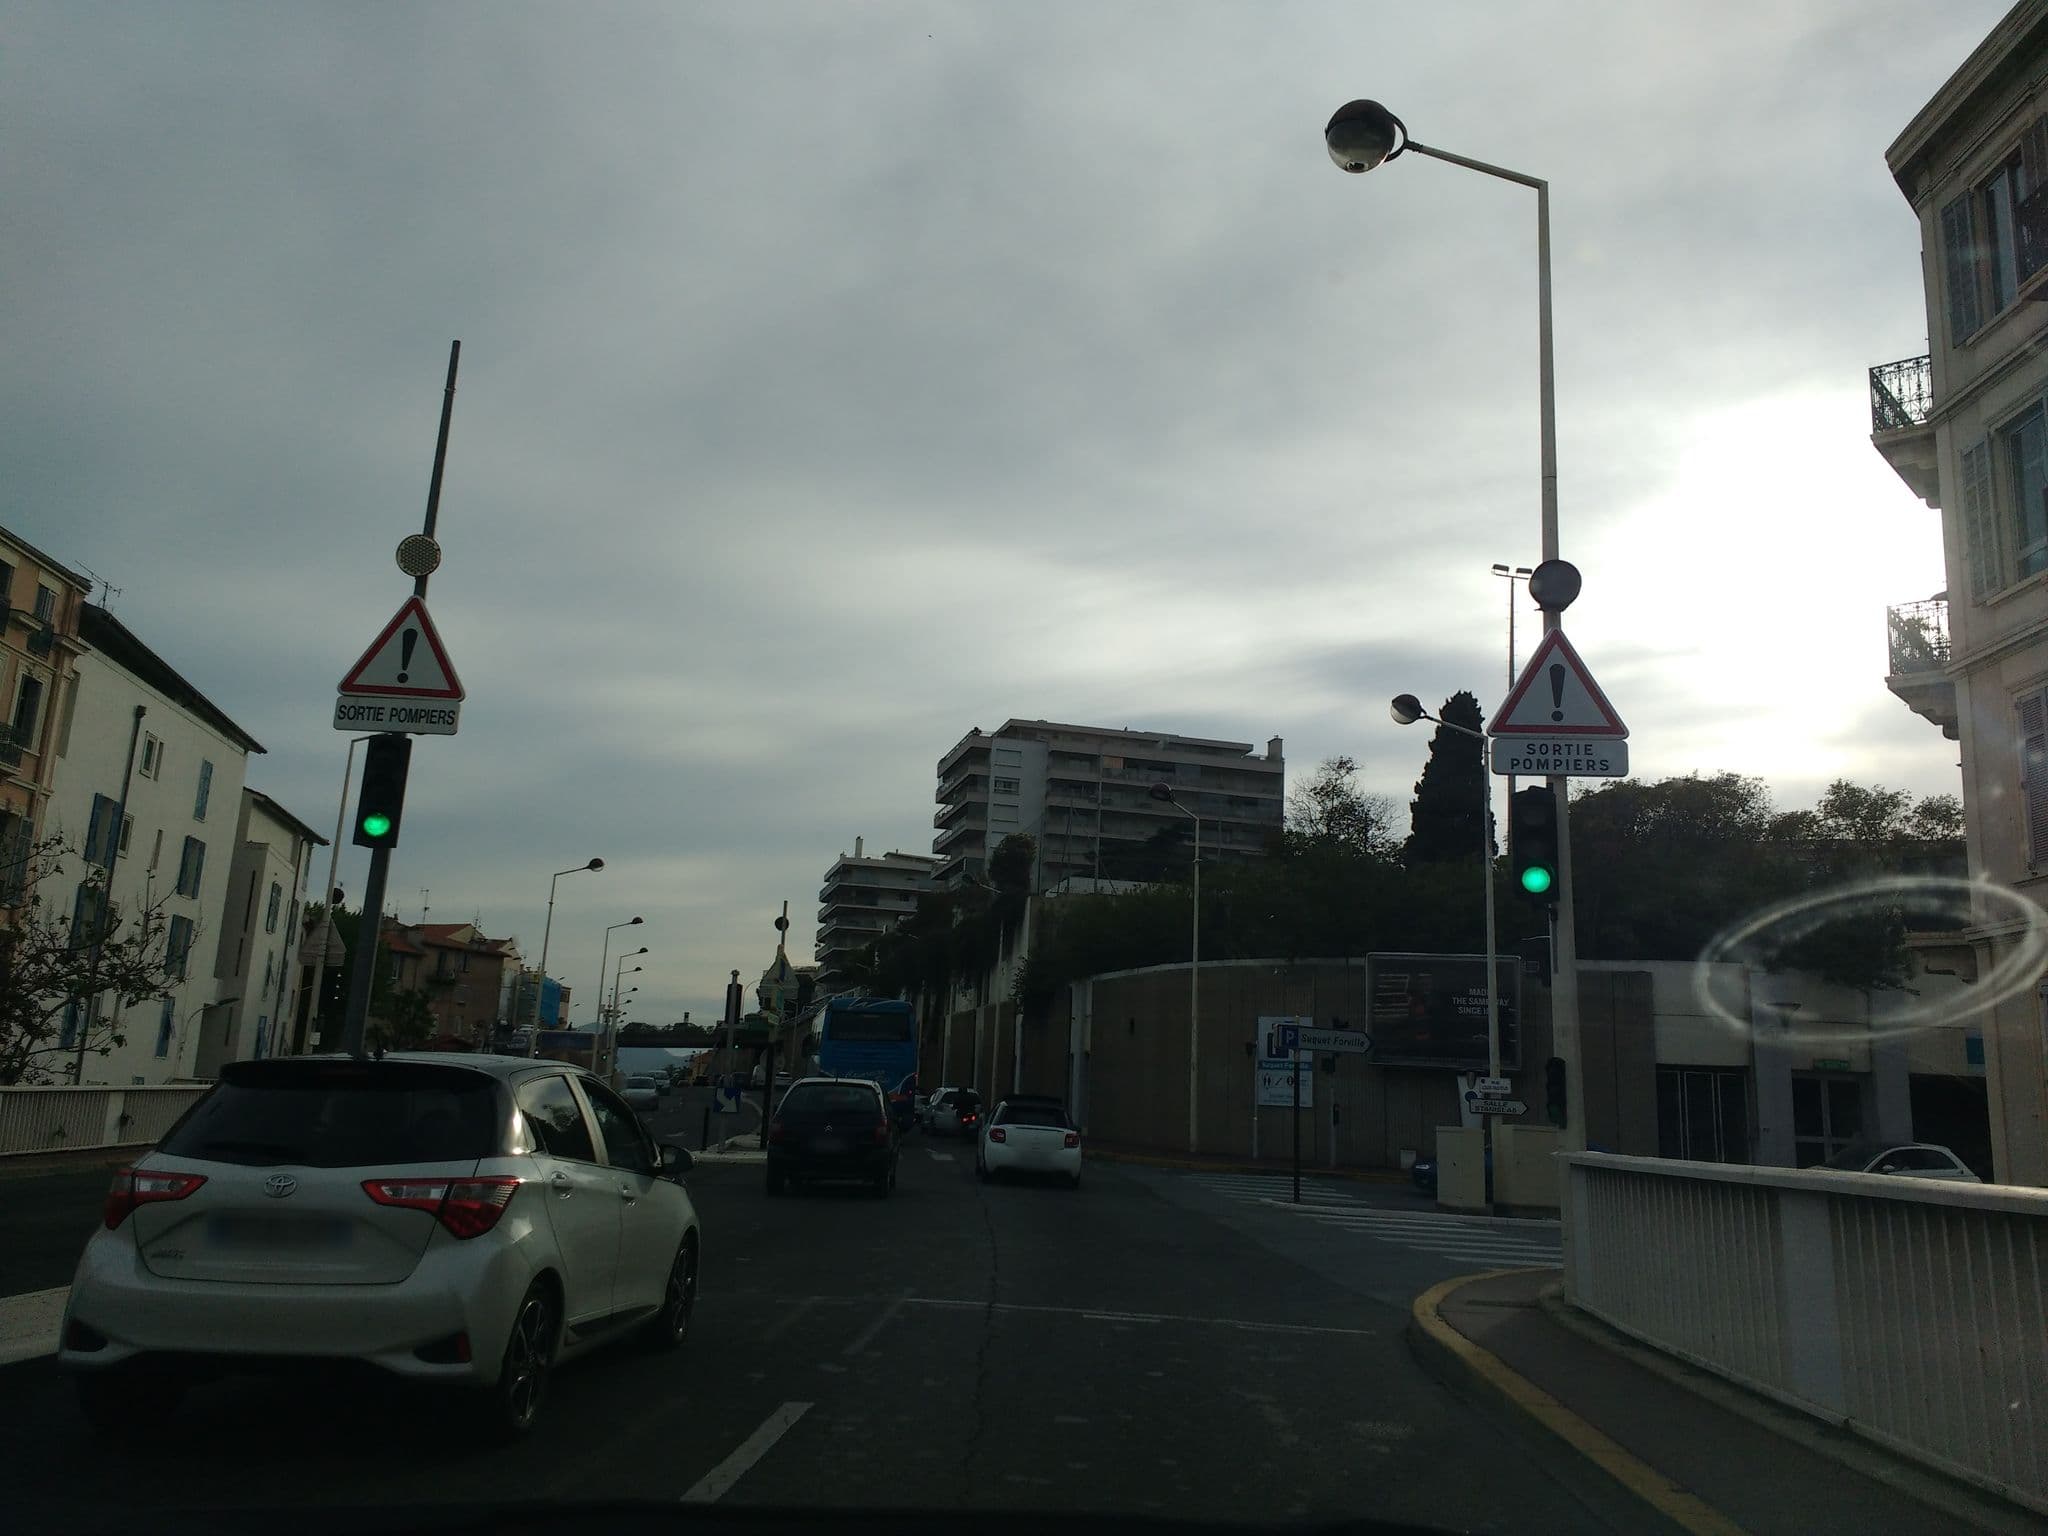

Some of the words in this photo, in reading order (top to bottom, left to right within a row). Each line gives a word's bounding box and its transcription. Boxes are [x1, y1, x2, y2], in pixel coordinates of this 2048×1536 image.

[338, 704, 385, 721] SORTIE
[389, 707, 456, 725] POMPIERS
[1526, 743, 1594, 756] SORTIE
[1510, 758, 1609, 771] POMPIERS
[1469, 988, 1489, 996] MAD
[1452, 997, 1467, 1005] THE
[1457, 1006, 1482, 1015] SINCE
[1302, 1033, 1330, 1048] Suquet
[1334, 1035, 1365, 1048] Forville
